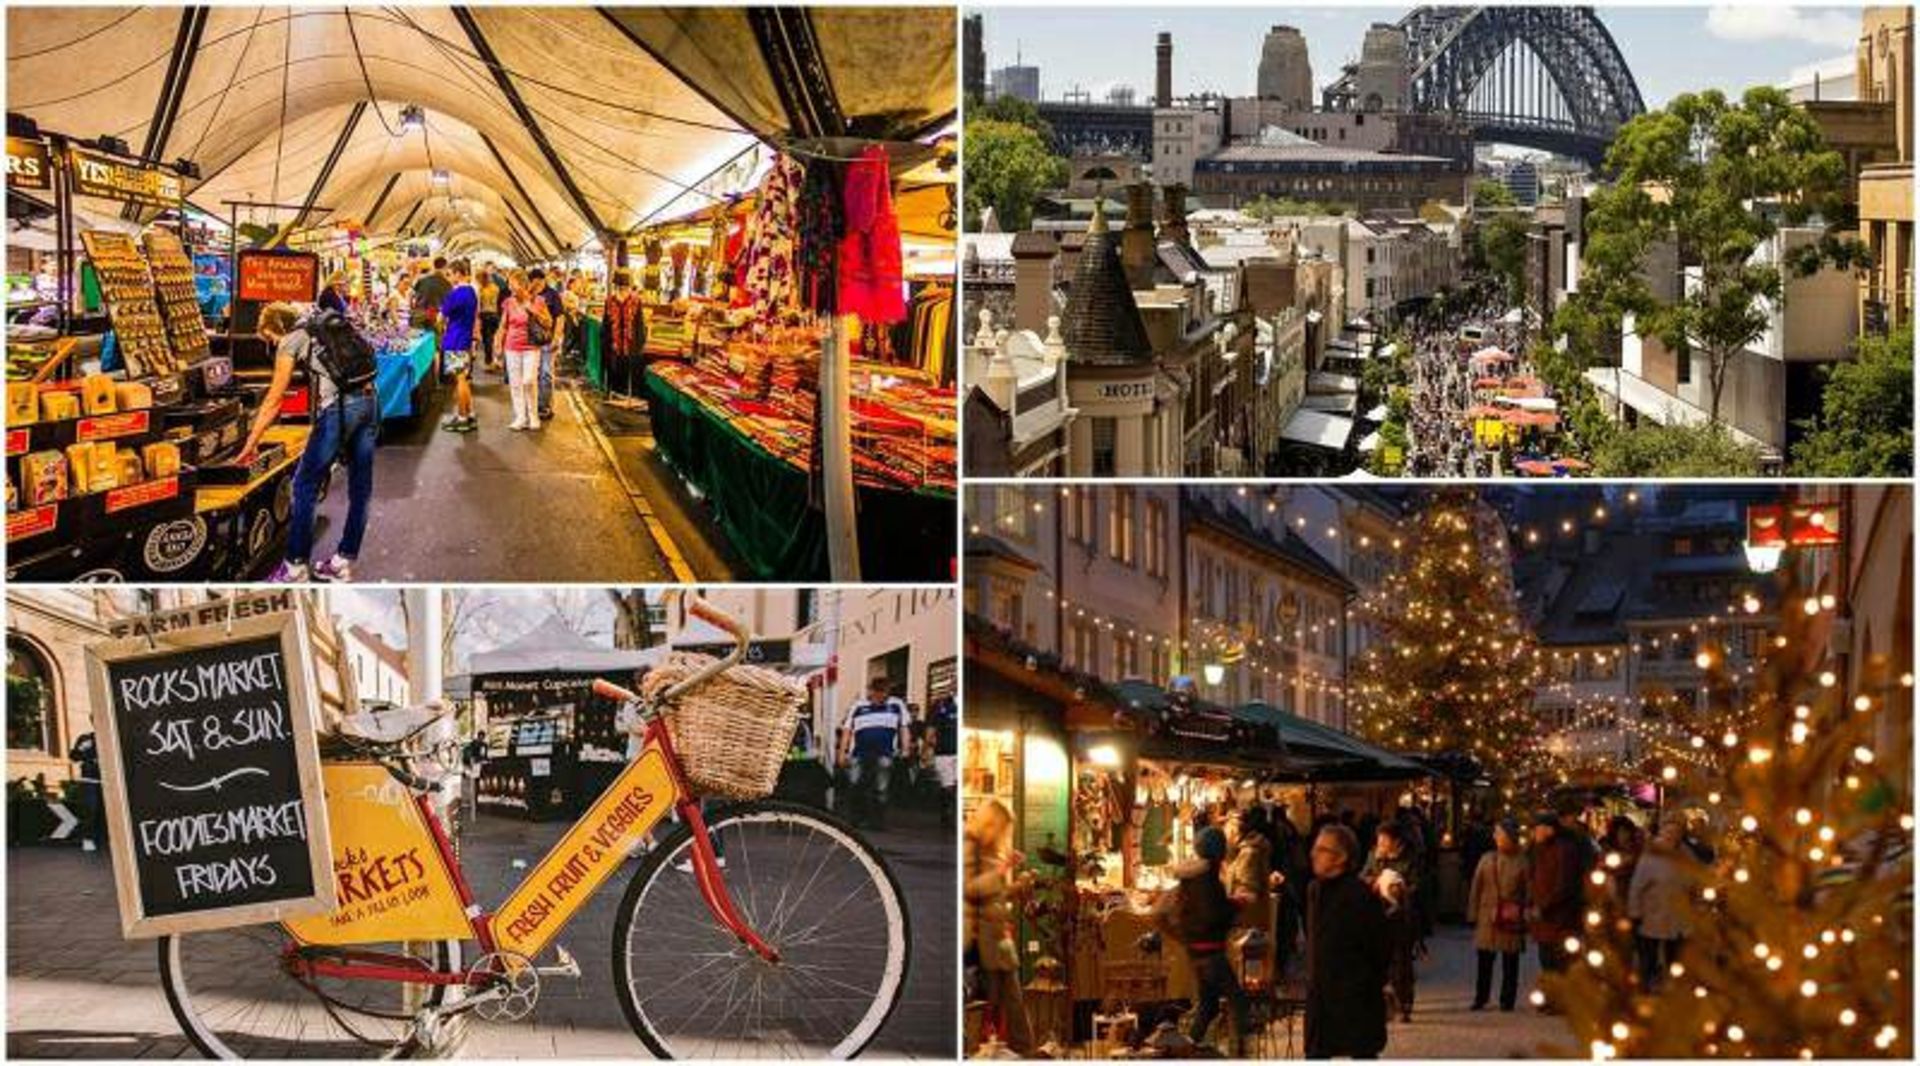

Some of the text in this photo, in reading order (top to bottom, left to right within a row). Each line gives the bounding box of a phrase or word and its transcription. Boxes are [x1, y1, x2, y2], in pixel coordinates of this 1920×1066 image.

[110, 590, 291, 639] FARM FRESH
[120, 653, 282, 711] ROCKS MARKET
[203, 715, 231, 749] &
[140, 800, 306, 855] FOODIES MARKET
[176, 854, 277, 898] FRIDAYS
[505, 786, 654, 944] FRESH FRUIT & VEGGIES
